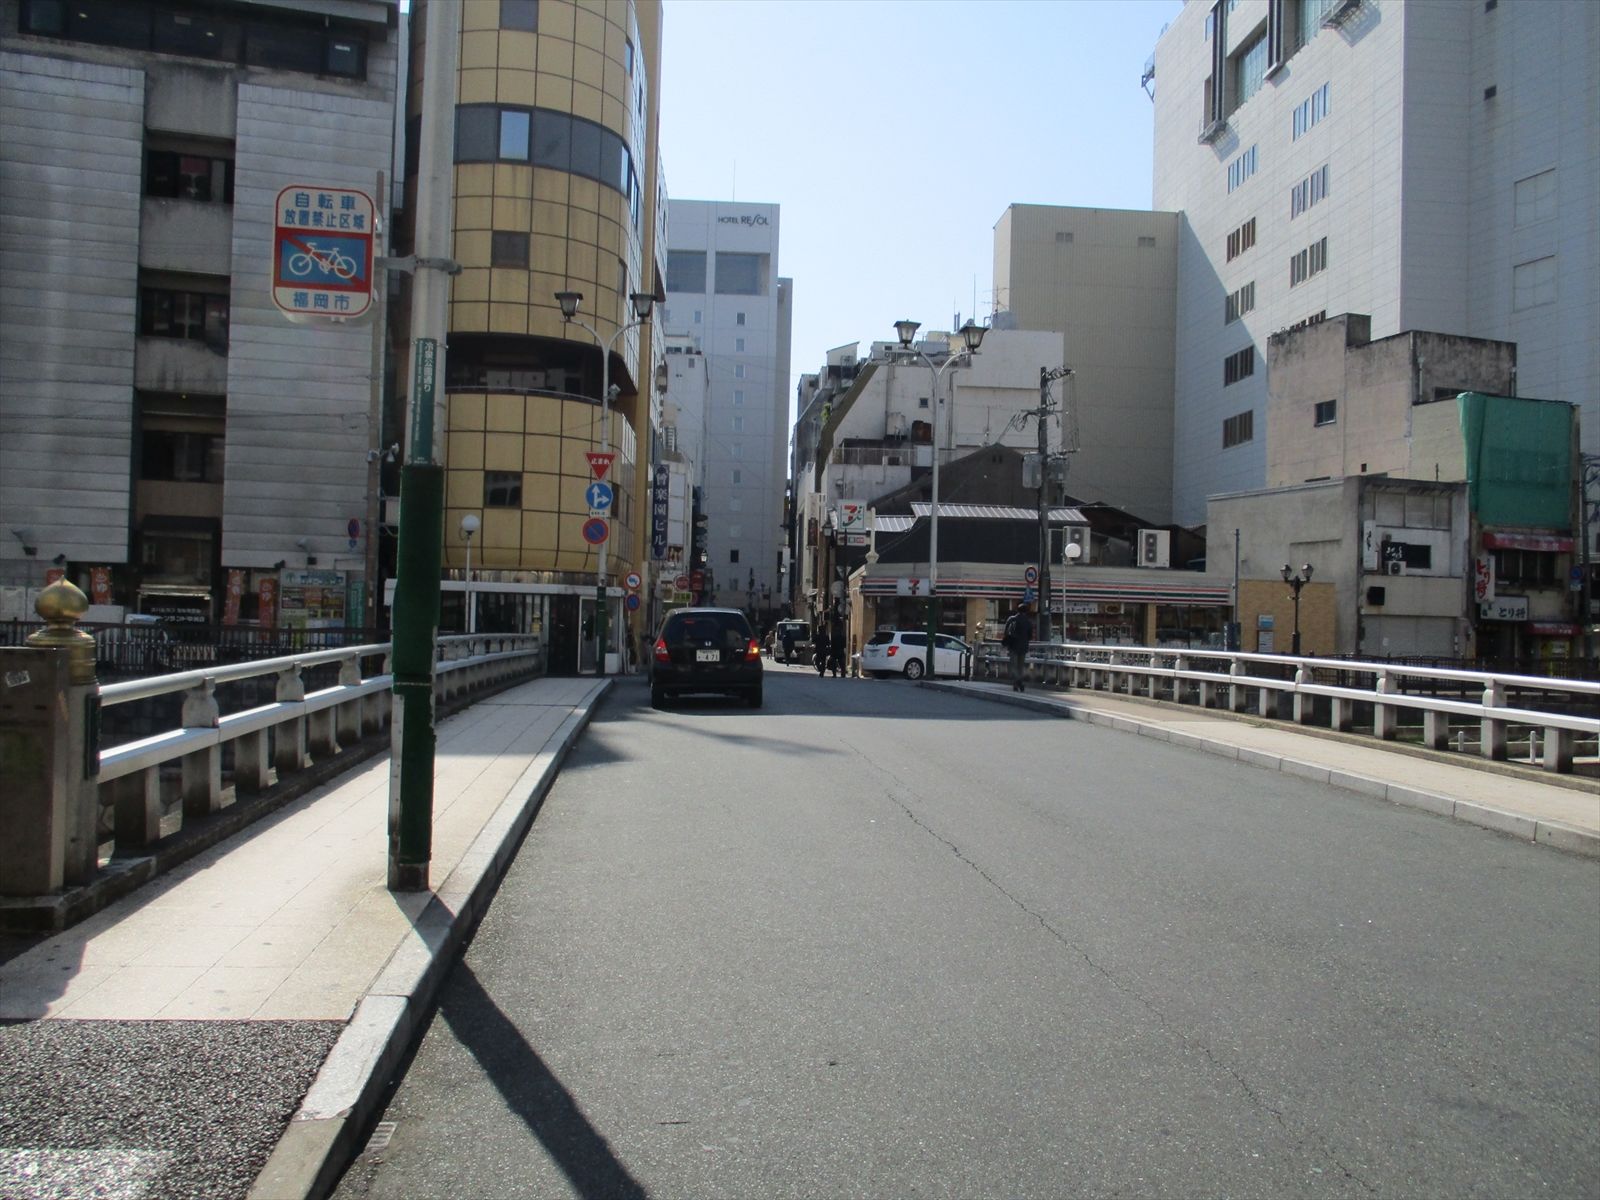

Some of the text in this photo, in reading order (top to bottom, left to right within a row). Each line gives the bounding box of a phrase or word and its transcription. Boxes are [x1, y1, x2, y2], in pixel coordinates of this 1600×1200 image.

[295, 192, 356, 210] 自転車
[284, 209, 365, 229] 放置禁止区域
[717, 216, 739, 224] HOTEL
[293, 291, 350, 310] 福岡市
